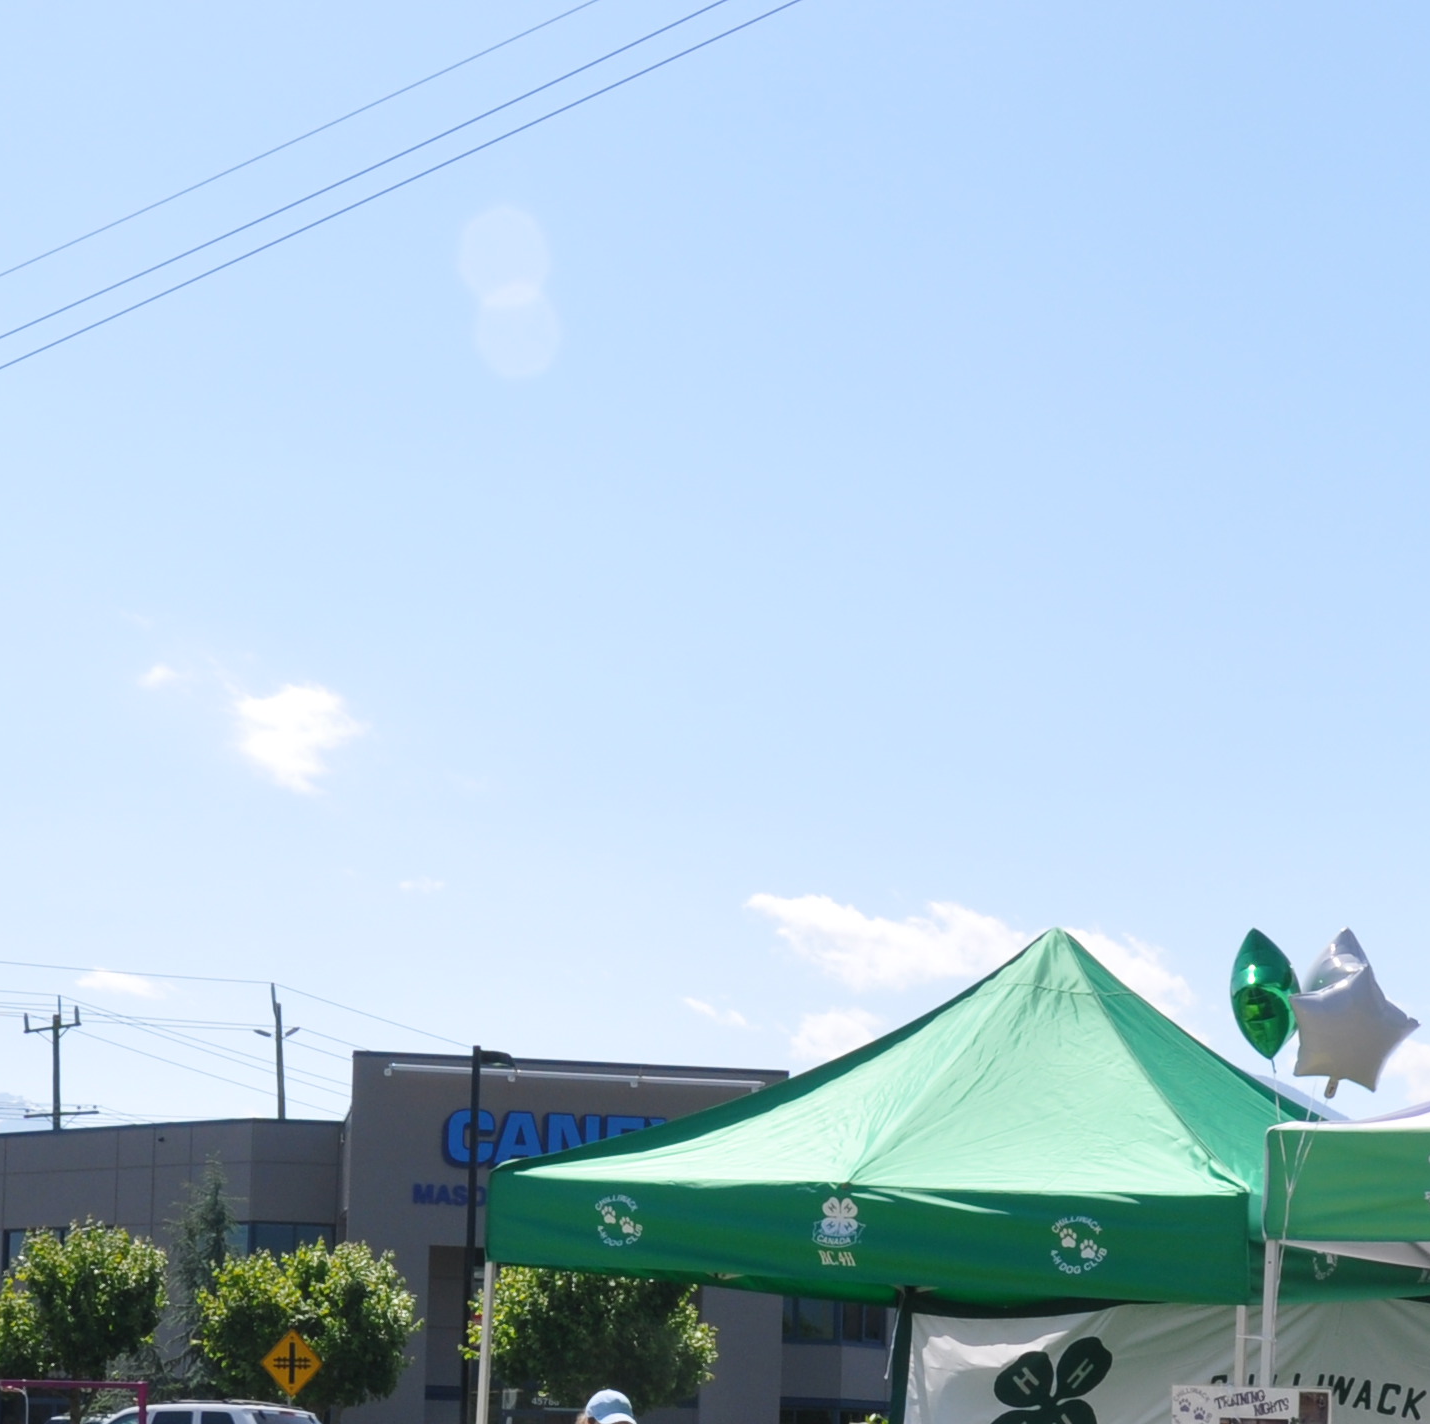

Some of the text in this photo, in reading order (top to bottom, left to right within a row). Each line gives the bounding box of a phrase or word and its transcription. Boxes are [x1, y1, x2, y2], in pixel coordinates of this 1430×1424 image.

[816, 1234, 852, 1245] CANADA
[1058, 1263, 1082, 1275] DOG
[1083, 1247, 1108, 1272] CLUB
[1214, 1389, 1266, 1410] TRAINING
